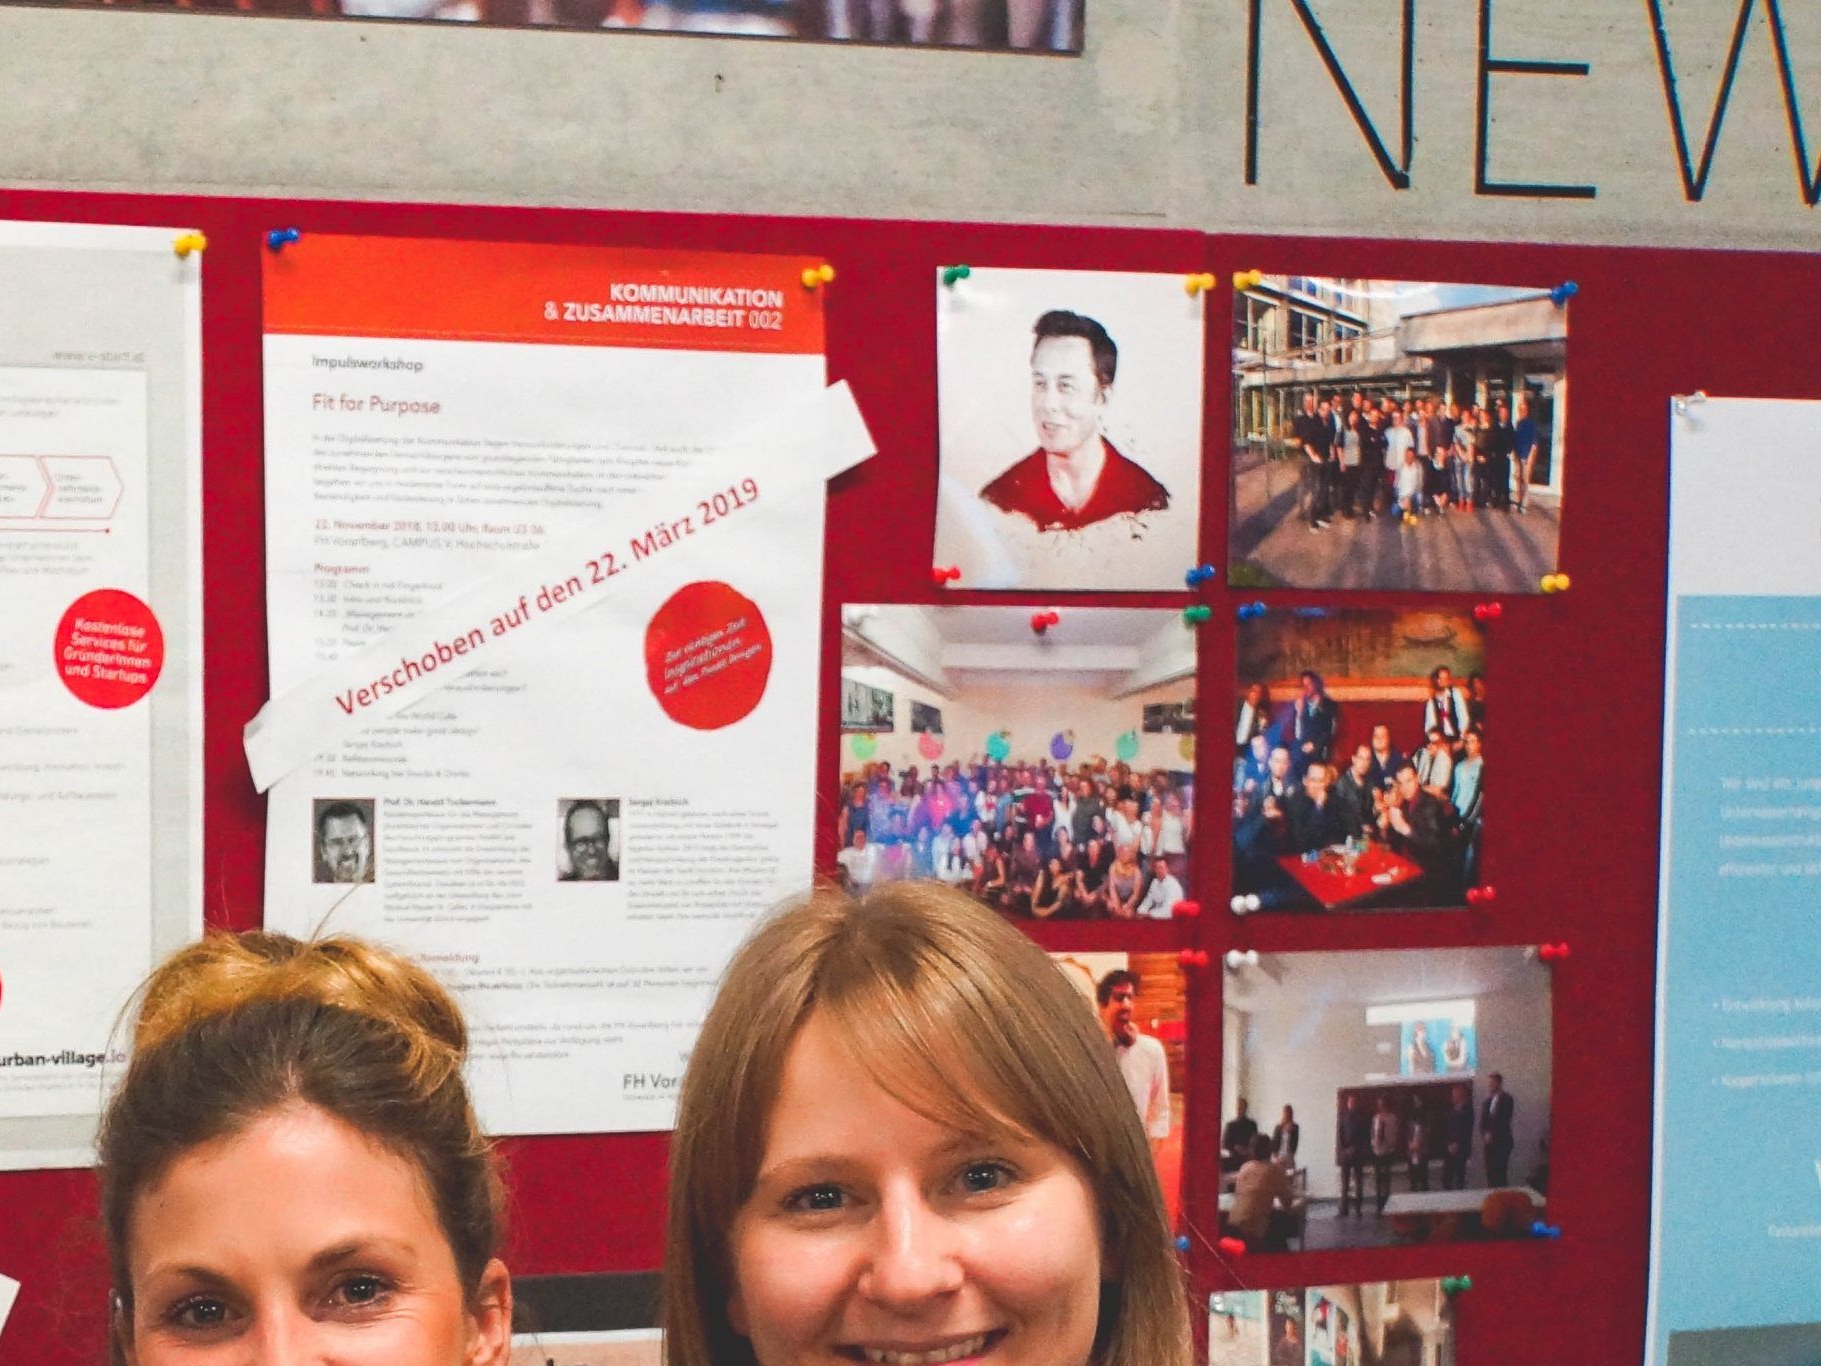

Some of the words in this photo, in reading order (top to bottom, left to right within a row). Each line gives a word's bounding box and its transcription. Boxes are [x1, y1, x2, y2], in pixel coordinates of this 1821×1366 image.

[610, 283, 783, 308] KOMMUNIKATION
[543, 301, 559, 321] &
[563, 302, 746, 328] ZUSAMMENARBEIT
[748, 310, 783, 330] 002
[312, 355, 424, 373] Impulsworkshop
[312, 393, 334, 411] Fit
[339, 393, 364, 412] for
[369, 395, 442, 417] Purpose
[335, 628, 485, 715] Verschoben
[491, 595, 531, 637] auf
[536, 576, 584, 614] den
[585, 552, 628, 586] 22.
[629, 517, 695, 563] März
[697, 477, 760, 527] 2019
[75, 618, 146, 638] Kostenlose
[71, 632, 125, 650] Services
[64, 664, 90, 677] und
[93, 665, 148, 684] Startups
[623, 1073, 644, 1088] FH
